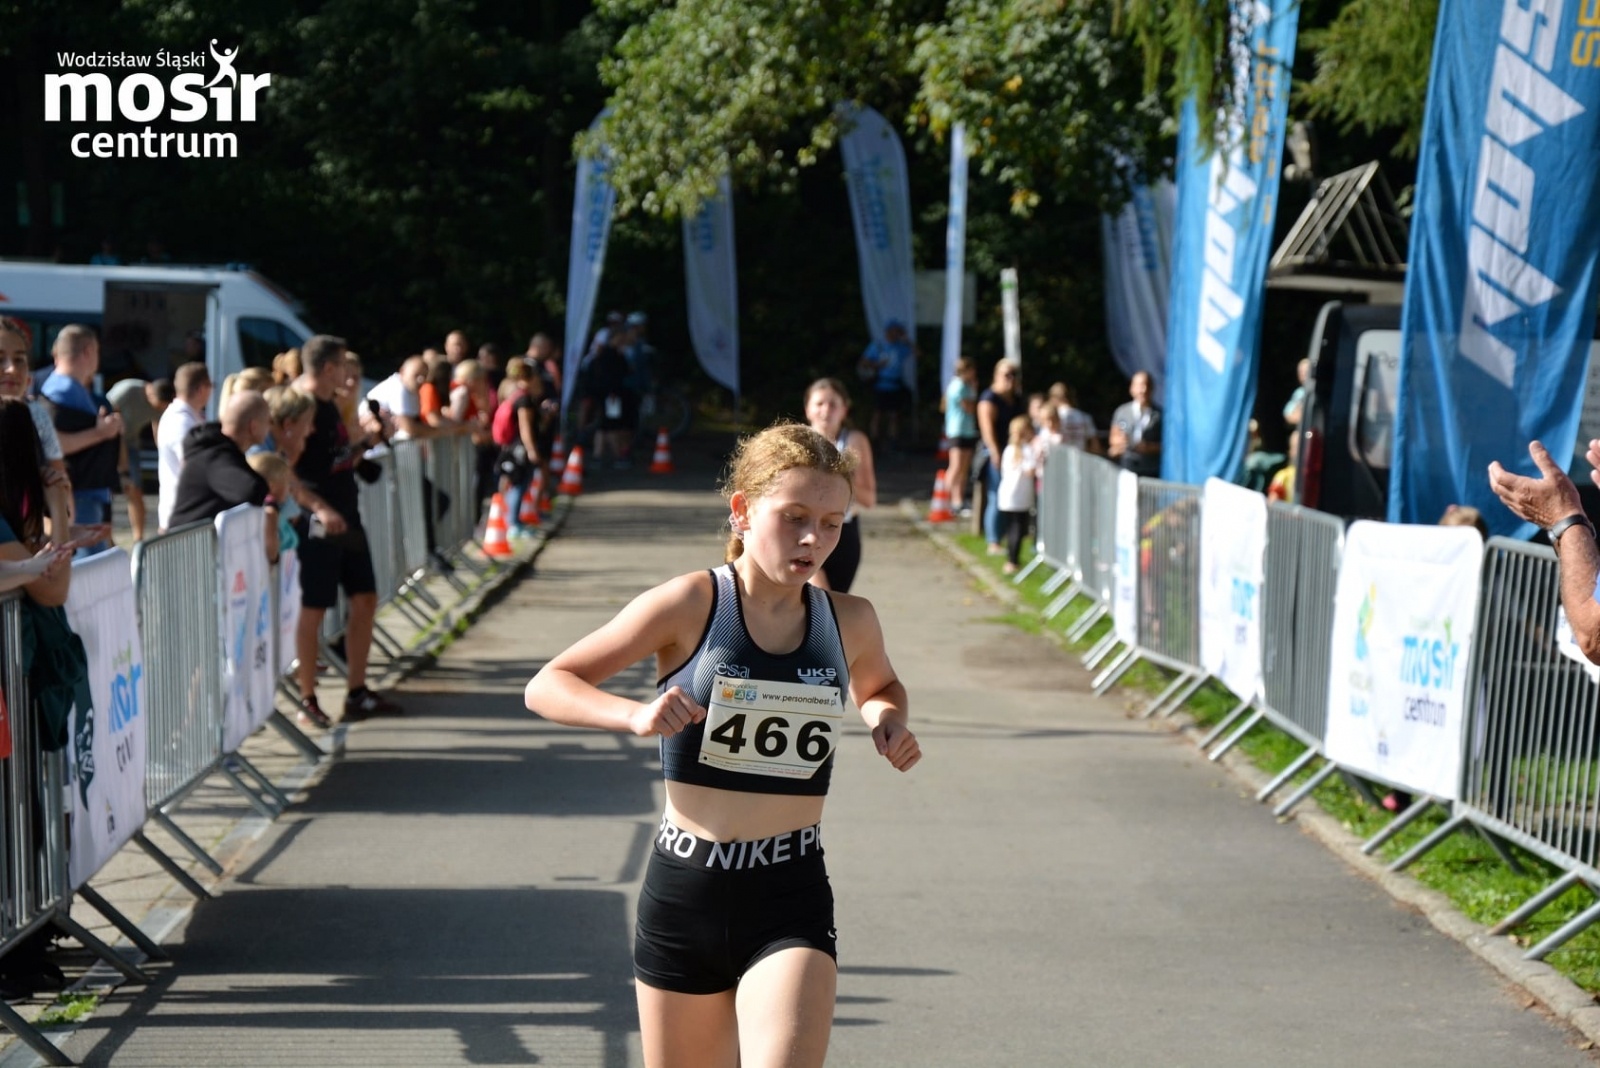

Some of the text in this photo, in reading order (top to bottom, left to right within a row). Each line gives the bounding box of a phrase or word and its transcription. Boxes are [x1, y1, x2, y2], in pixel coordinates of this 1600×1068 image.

[797, 667, 837, 677] UKS
[762, 693, 837, 707] www.personalbest.pl
[709, 713, 833, 763] 466
[705, 833, 793, 871] NIKE
